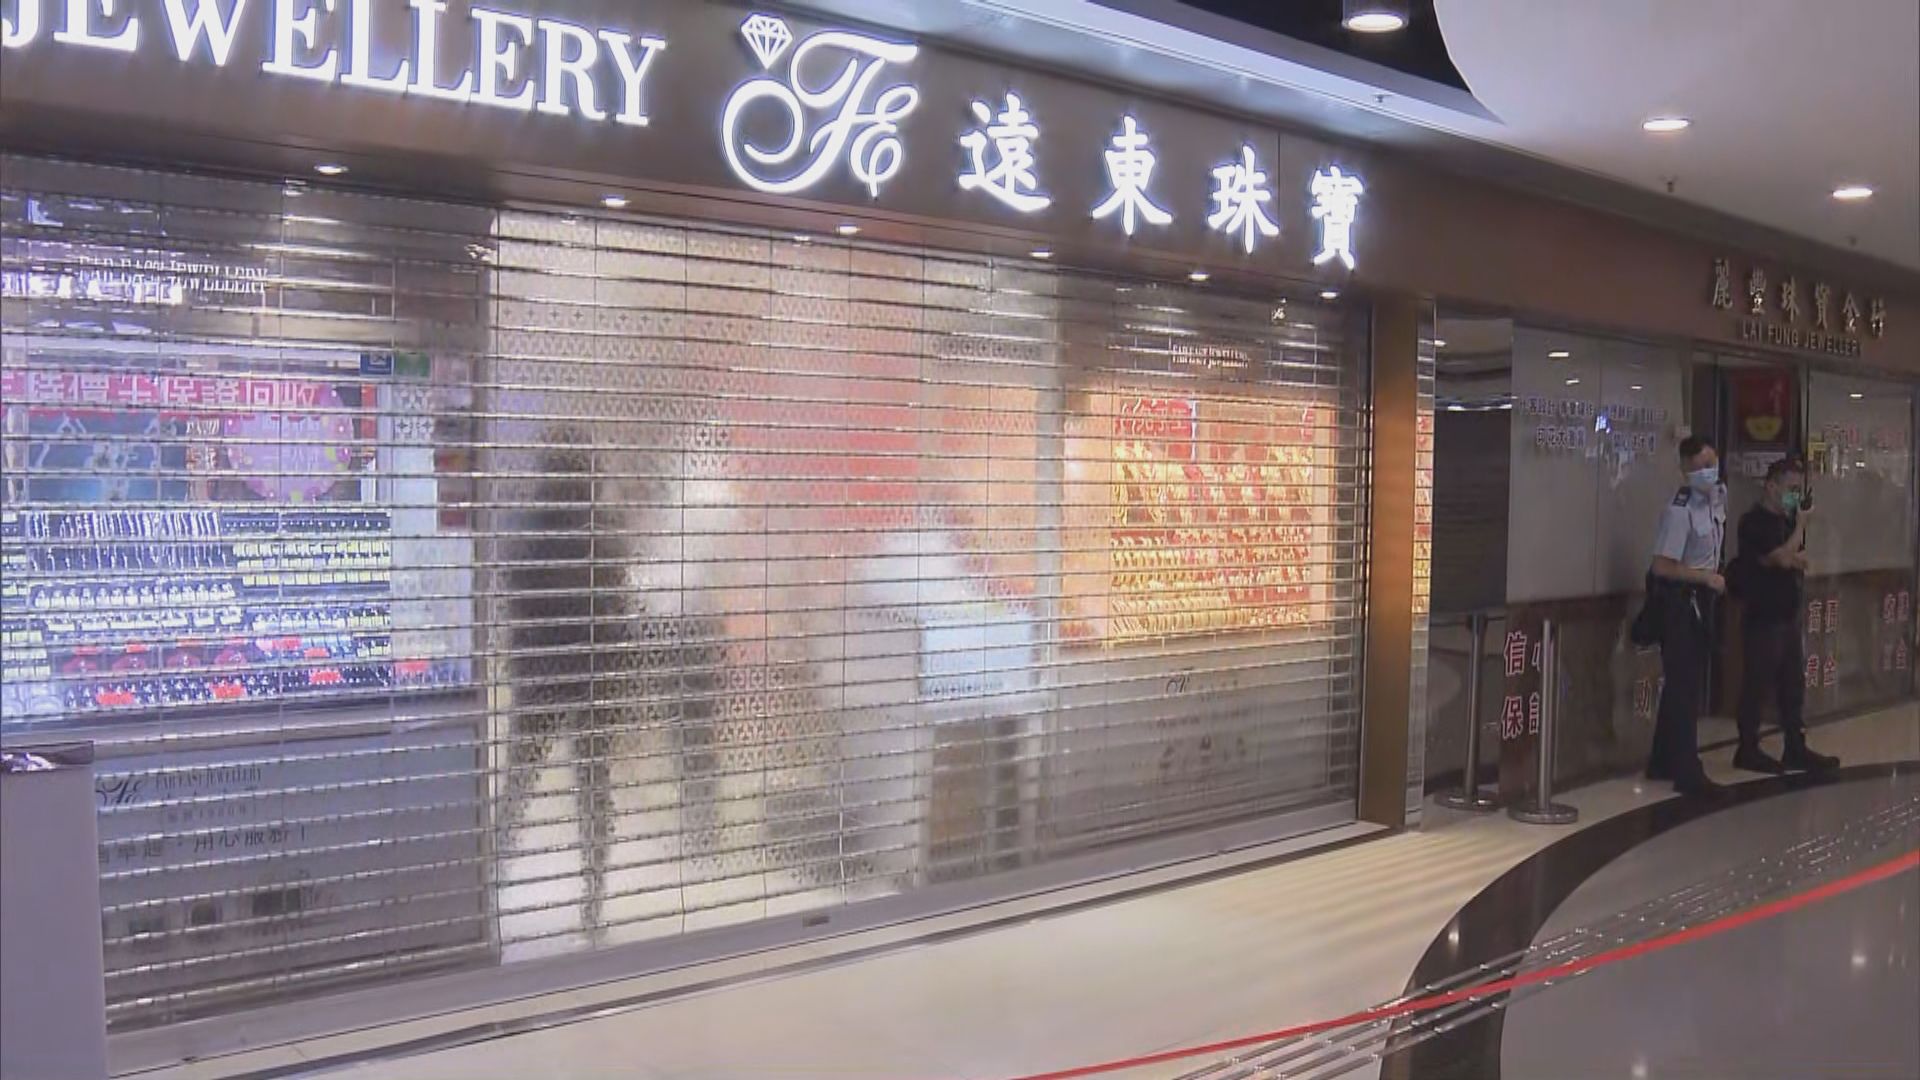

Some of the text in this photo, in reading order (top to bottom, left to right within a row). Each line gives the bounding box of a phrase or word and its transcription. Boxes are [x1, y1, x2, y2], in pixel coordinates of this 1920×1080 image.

[959, 92, 1364, 270] 遠東珠寶
[1742, 319, 1762, 340] LAI
[1768, 324, 1799, 347] FUNG
